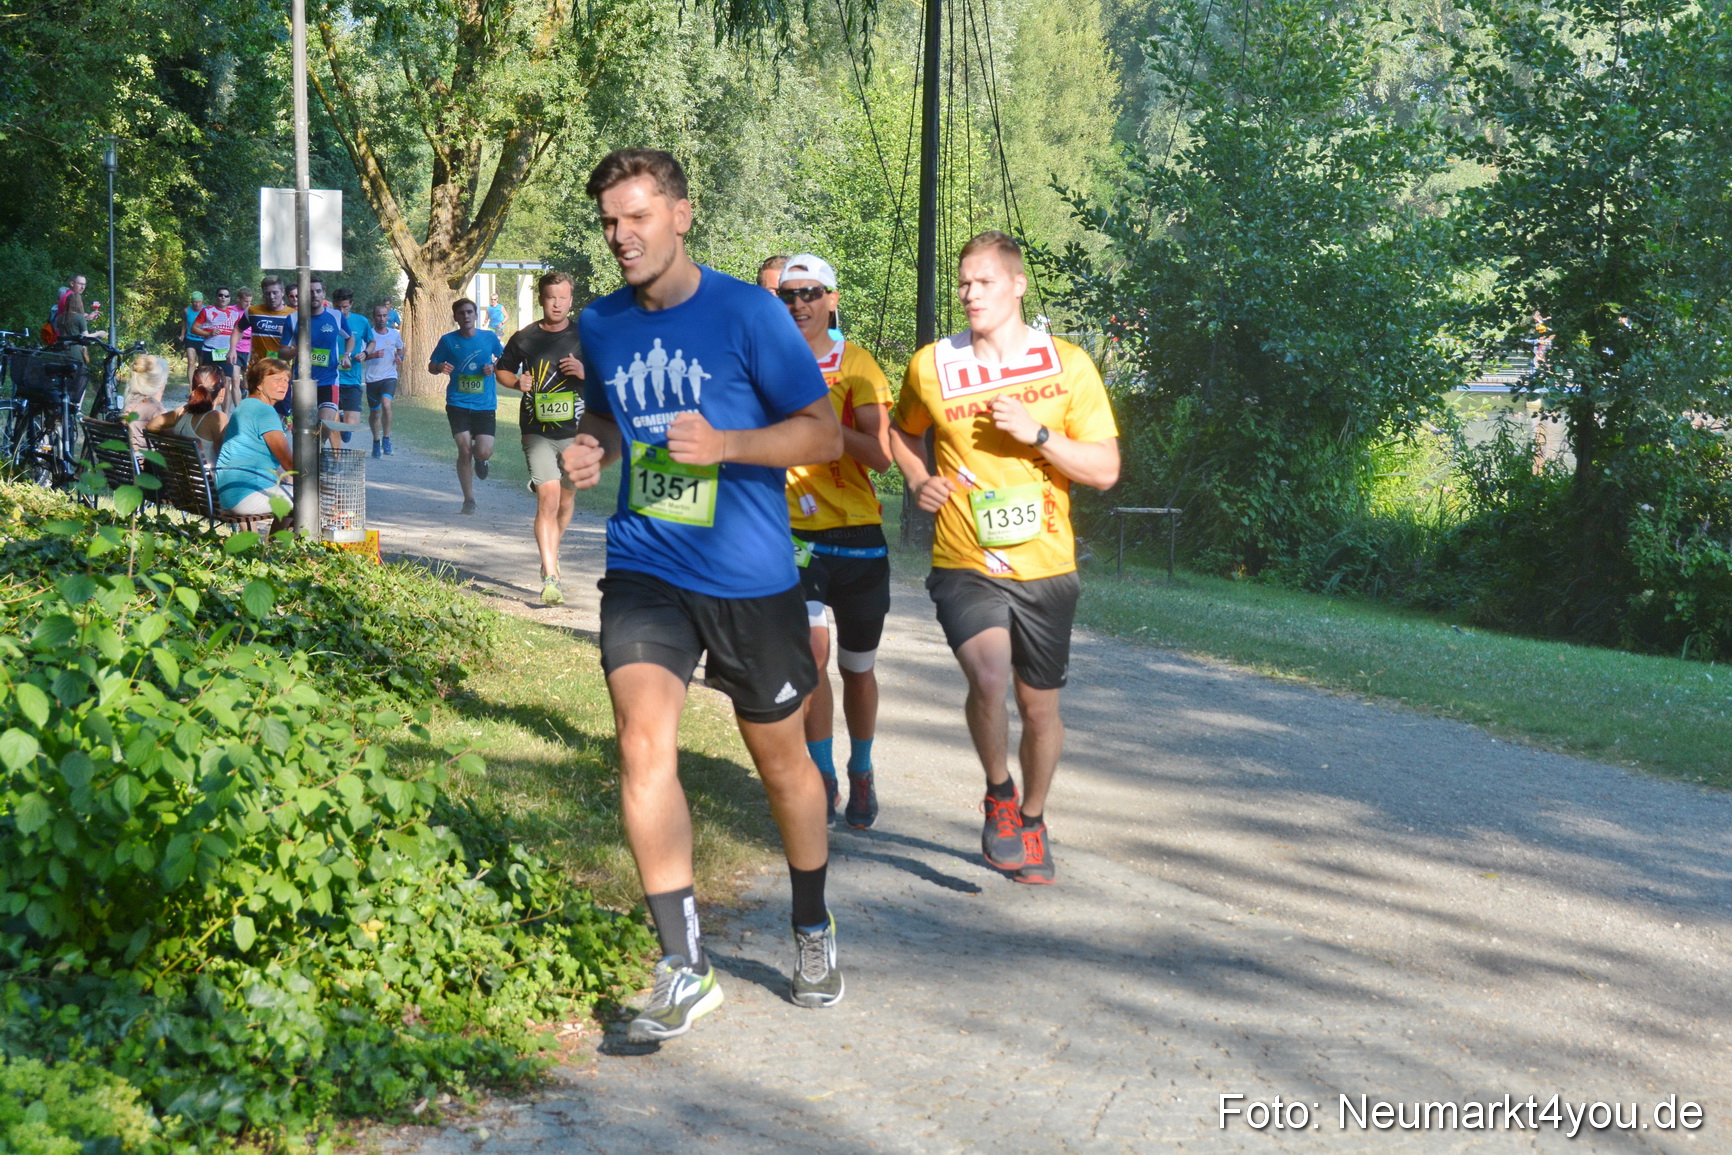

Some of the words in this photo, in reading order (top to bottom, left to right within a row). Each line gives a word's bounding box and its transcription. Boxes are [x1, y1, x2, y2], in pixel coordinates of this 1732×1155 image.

[461, 381, 481, 389] 1190
[540, 402, 569, 414] 1420
[632, 408, 699, 428] GEMEIN
[638, 470, 700, 504] 1351
[983, 503, 1037, 530] 1335
